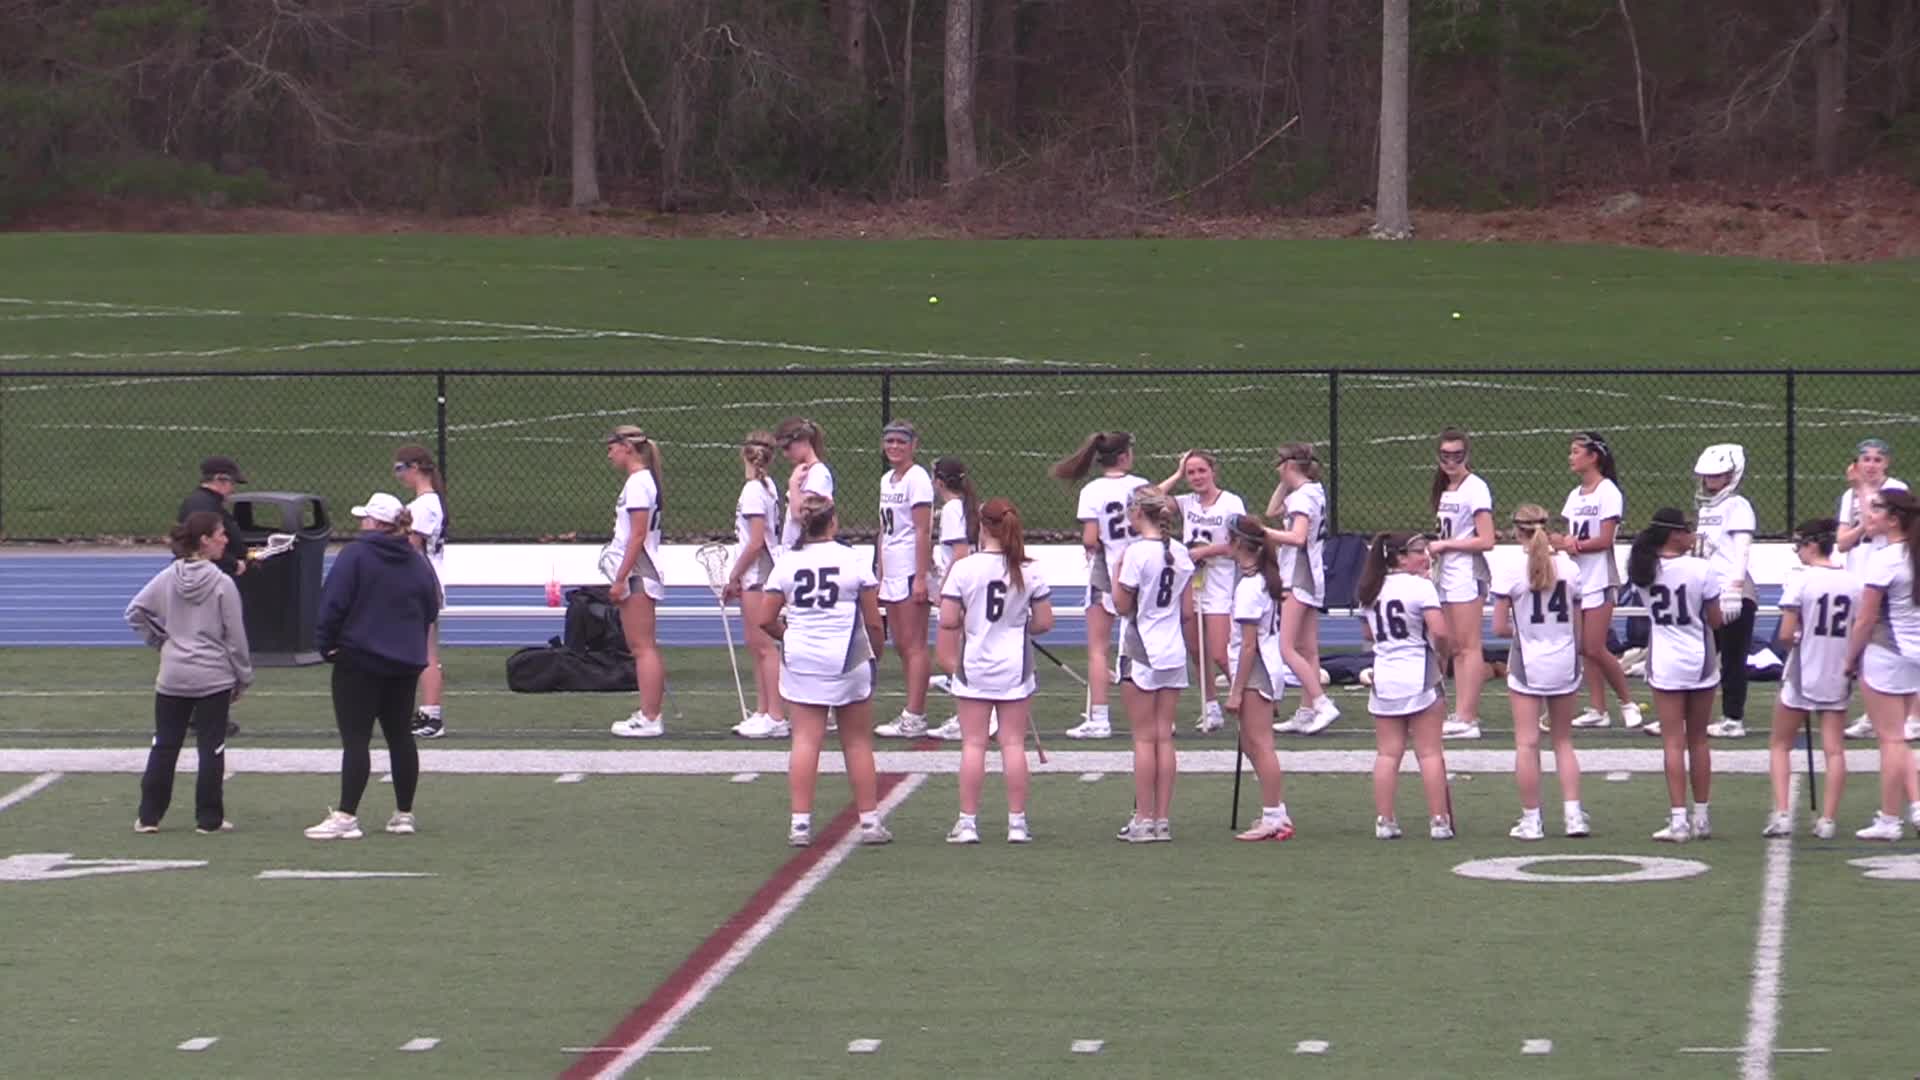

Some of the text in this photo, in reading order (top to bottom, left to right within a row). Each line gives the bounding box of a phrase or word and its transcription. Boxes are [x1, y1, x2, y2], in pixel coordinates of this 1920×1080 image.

[792, 567, 840, 609] 25
[986, 580, 1007, 623] 6
[1156, 567, 1175, 608] 8
[1530, 580, 1569, 624] 14
[1649, 584, 1693, 627] 21
[1374, 600, 1409, 642] 16
[1813, 593, 1852, 638] 12
